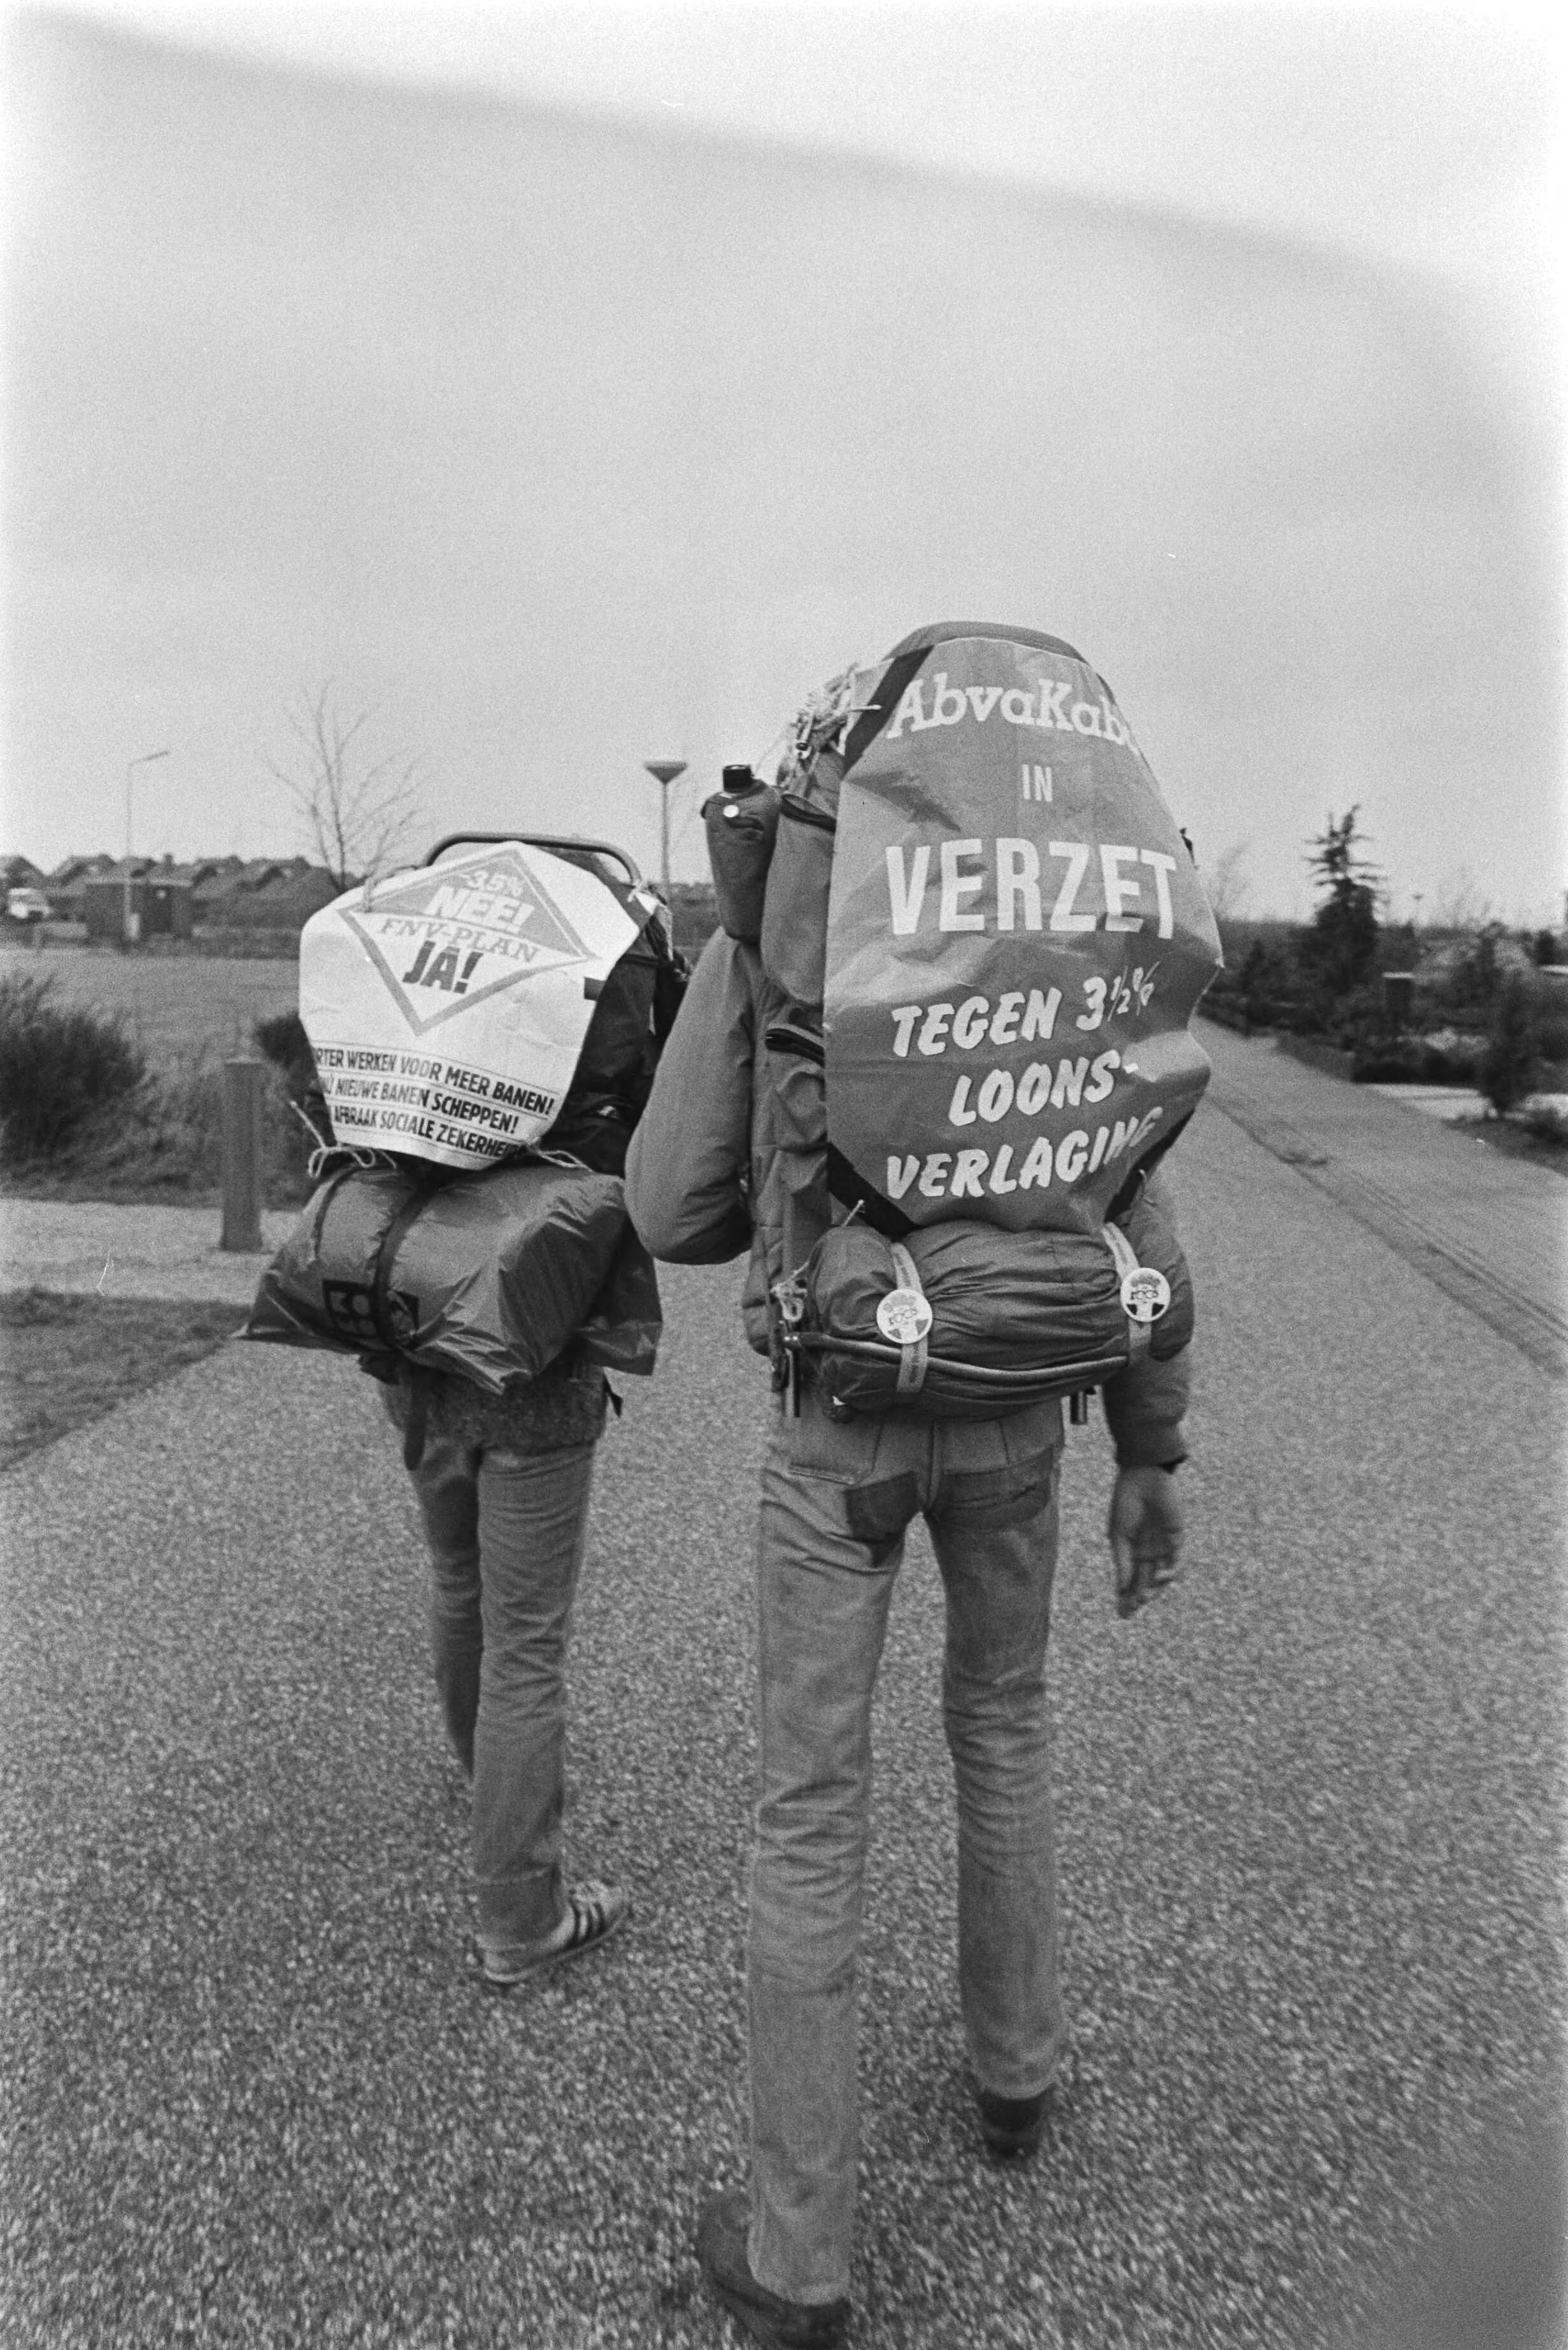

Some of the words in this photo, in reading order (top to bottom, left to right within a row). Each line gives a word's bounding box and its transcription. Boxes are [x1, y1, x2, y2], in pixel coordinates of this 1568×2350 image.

[1022, 764, 1053, 802] IN
[422, 885, 535, 934] NEE!
[885, 837, 1176, 940] VERZET
[378, 917, 541, 964] FNV-PLAN
[402, 939, 484, 994] JA!
[892, 987, 1062, 1057] TEGEN
[314, 1047, 344, 1067] RTER
[347, 1051, 397, 1072] WERKEN
[401, 1055, 443, 1081] VOOR
[445, 1065, 491, 1096] MEER
[492, 1081, 555, 1115] BANEN!
[335, 1078, 380, 1099] NIEUWE
[380, 1081, 431, 1107] BANEN
[431, 1092, 519, 1134] SCHEPPEN!
[948, 1049, 1139, 1126] LOONS-
[334, 1105, 377, 1127] AFBRAAK
[380, 1110, 436, 1139] SOCIALE
[887, 1106, 1164, 1199] VERLAGING
